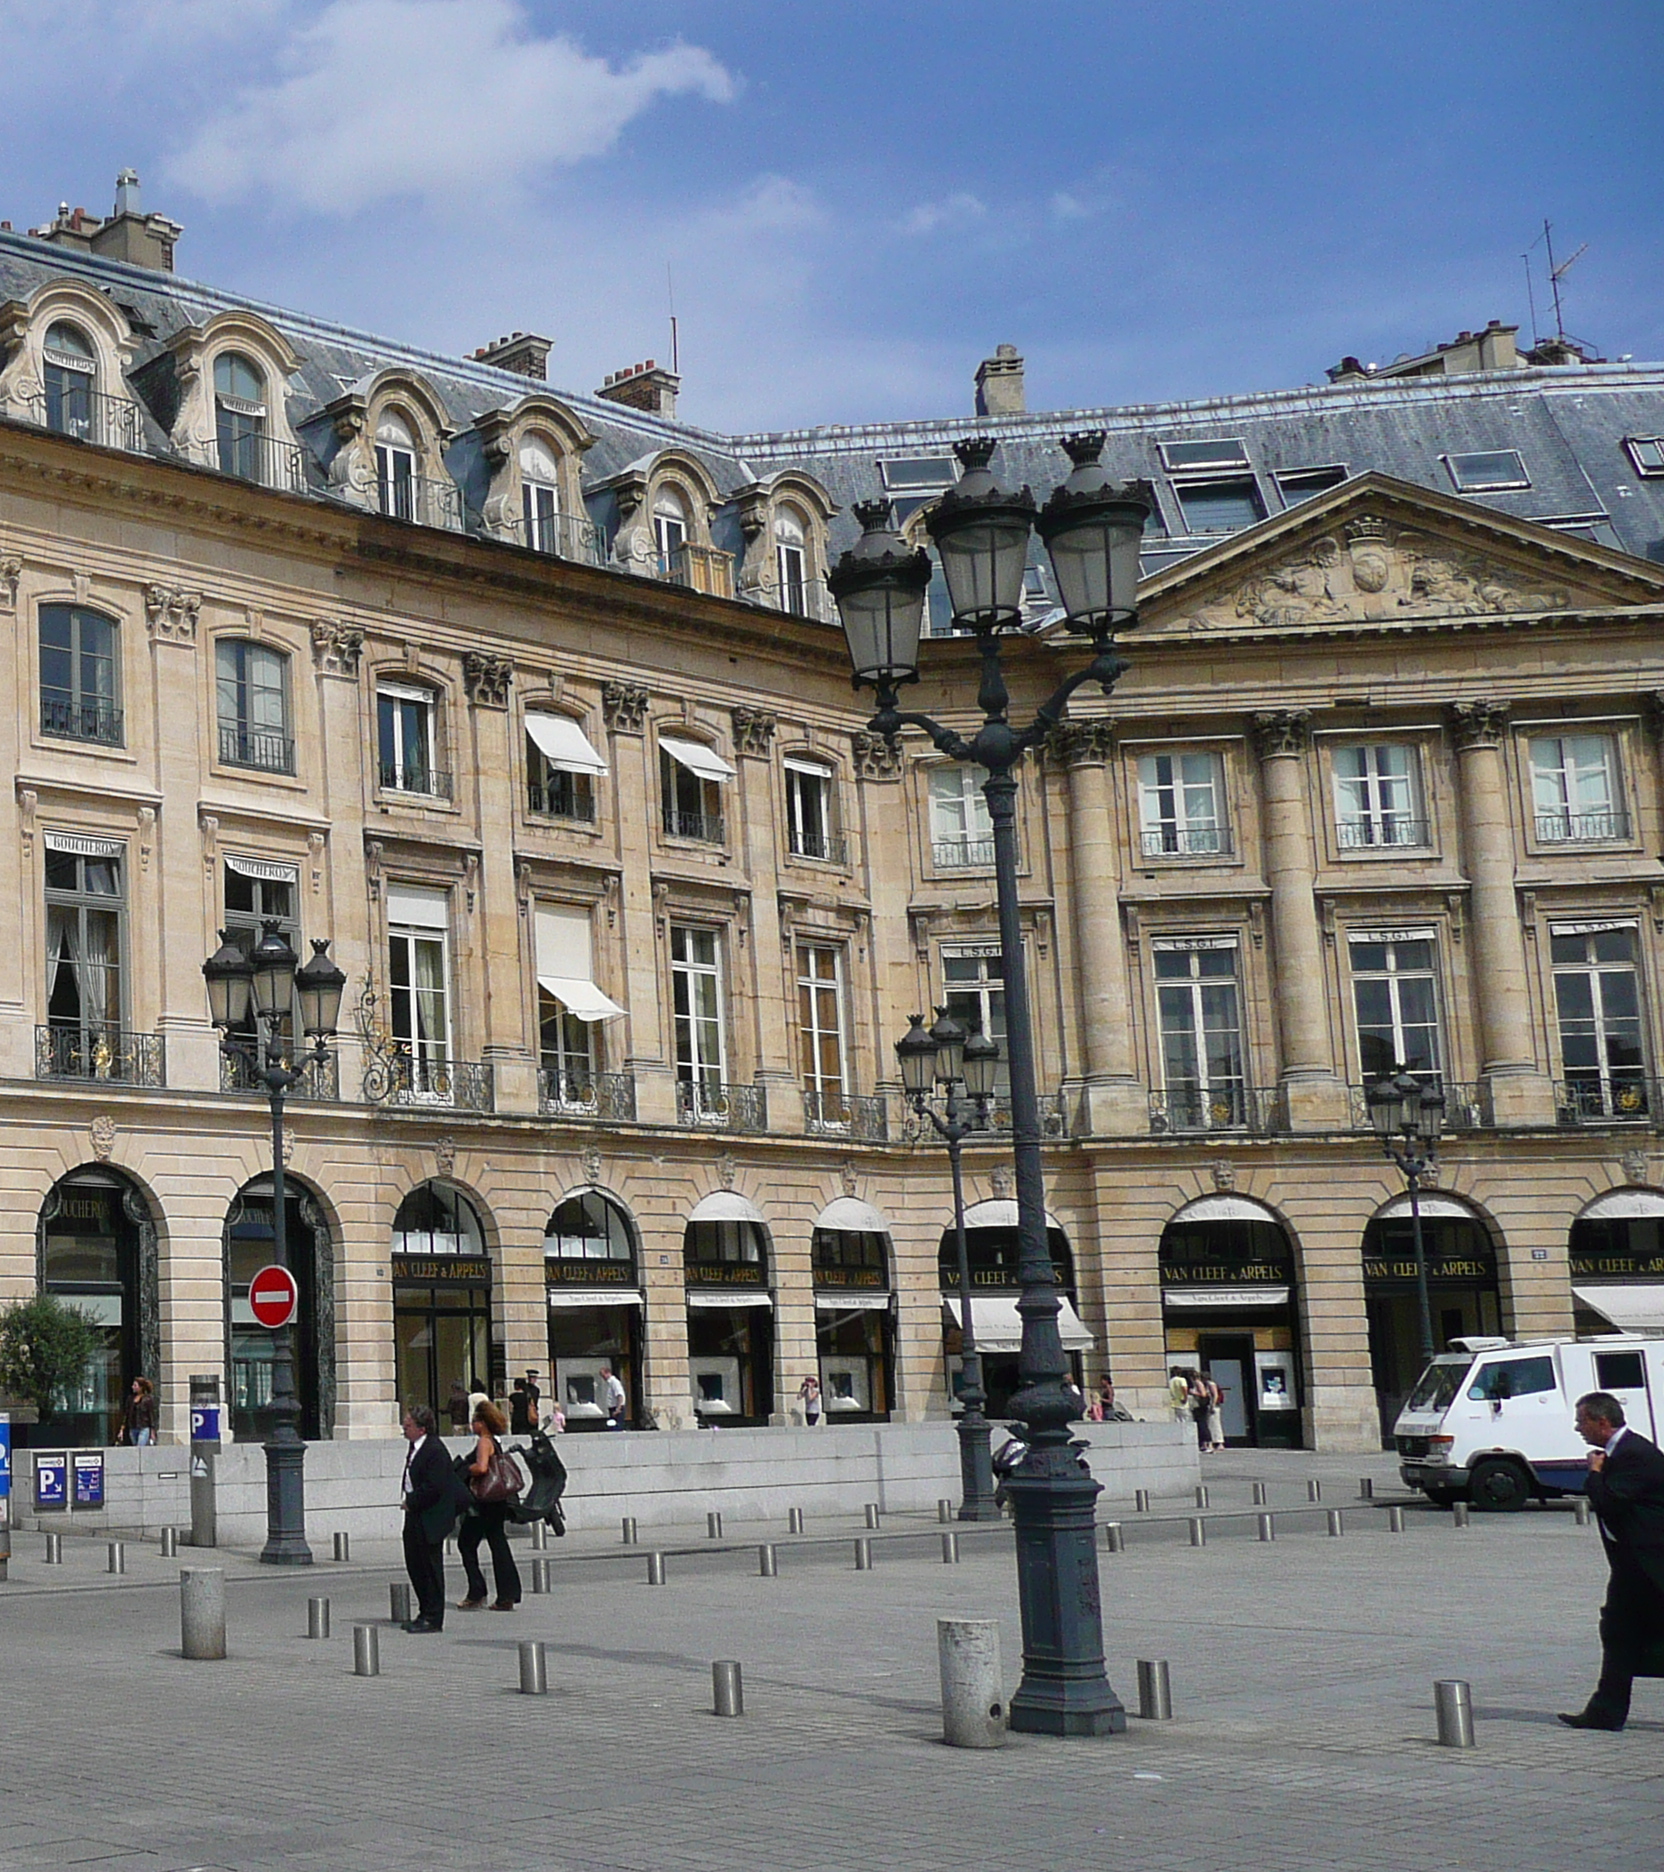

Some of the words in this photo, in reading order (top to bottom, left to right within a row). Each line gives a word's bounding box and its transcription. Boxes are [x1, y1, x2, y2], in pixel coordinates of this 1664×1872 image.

[393, 1262, 408, 1278] AN
[449, 1263, 487, 1279] ARPELS
[1164, 1266, 1188, 1281] VAN
[1192, 1266, 1228, 1280] CLEEF
[1239, 1265, 1283, 1280] ARPELS
[1364, 1262, 1388, 1277] VAN
[1441, 1261, 1486, 1276] ARPELS
[1569, 1258, 1594, 1273] VAN
[1598, 1258, 1634, 1273] CLEEF
[974, 1270, 1009, 1285] CLEEF
[192, 1413, 204, 1434] P
[40, 1469, 55, 1493] P
